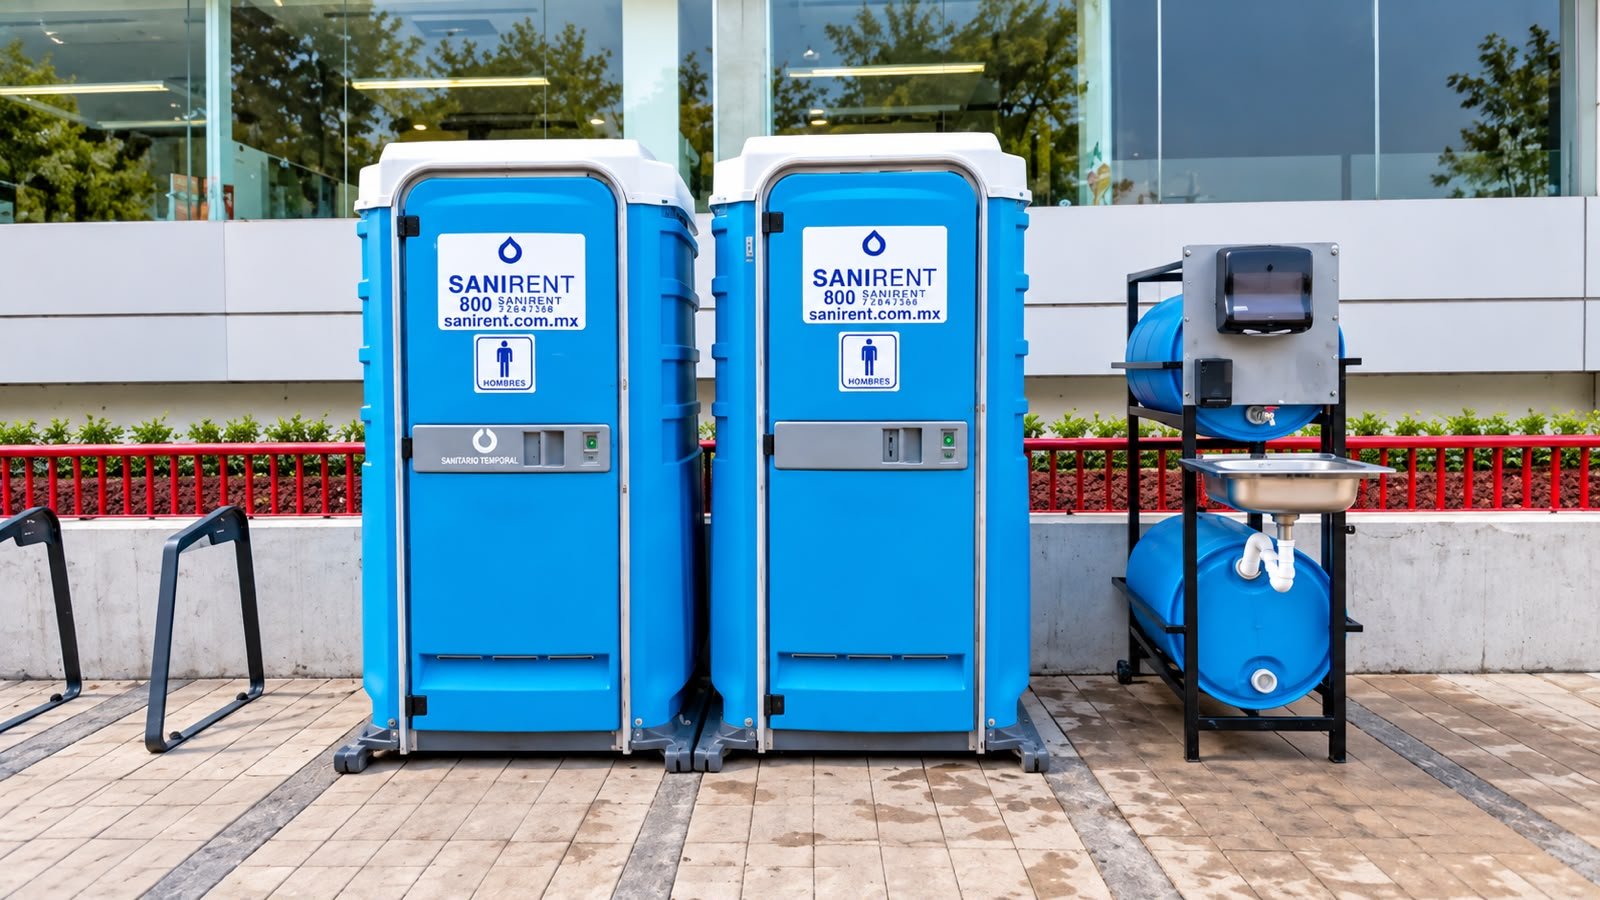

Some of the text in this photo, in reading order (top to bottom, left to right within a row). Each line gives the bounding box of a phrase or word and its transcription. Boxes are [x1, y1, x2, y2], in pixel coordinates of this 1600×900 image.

[449, 275, 575, 293] SANIRENT
[813, 268, 937, 287] SANIRENT
[459, 297, 562, 312] 800 SANIRENT
[824, 290, 926, 305] 800 SANIRENT
[444, 314, 579, 328] sanirent.com.mx
[809, 307, 941, 321] sanirent.com.mx
[848, 378, 890, 386] HOMBRES
[441, 457, 519, 465] SANITARIO TEMPORAL
